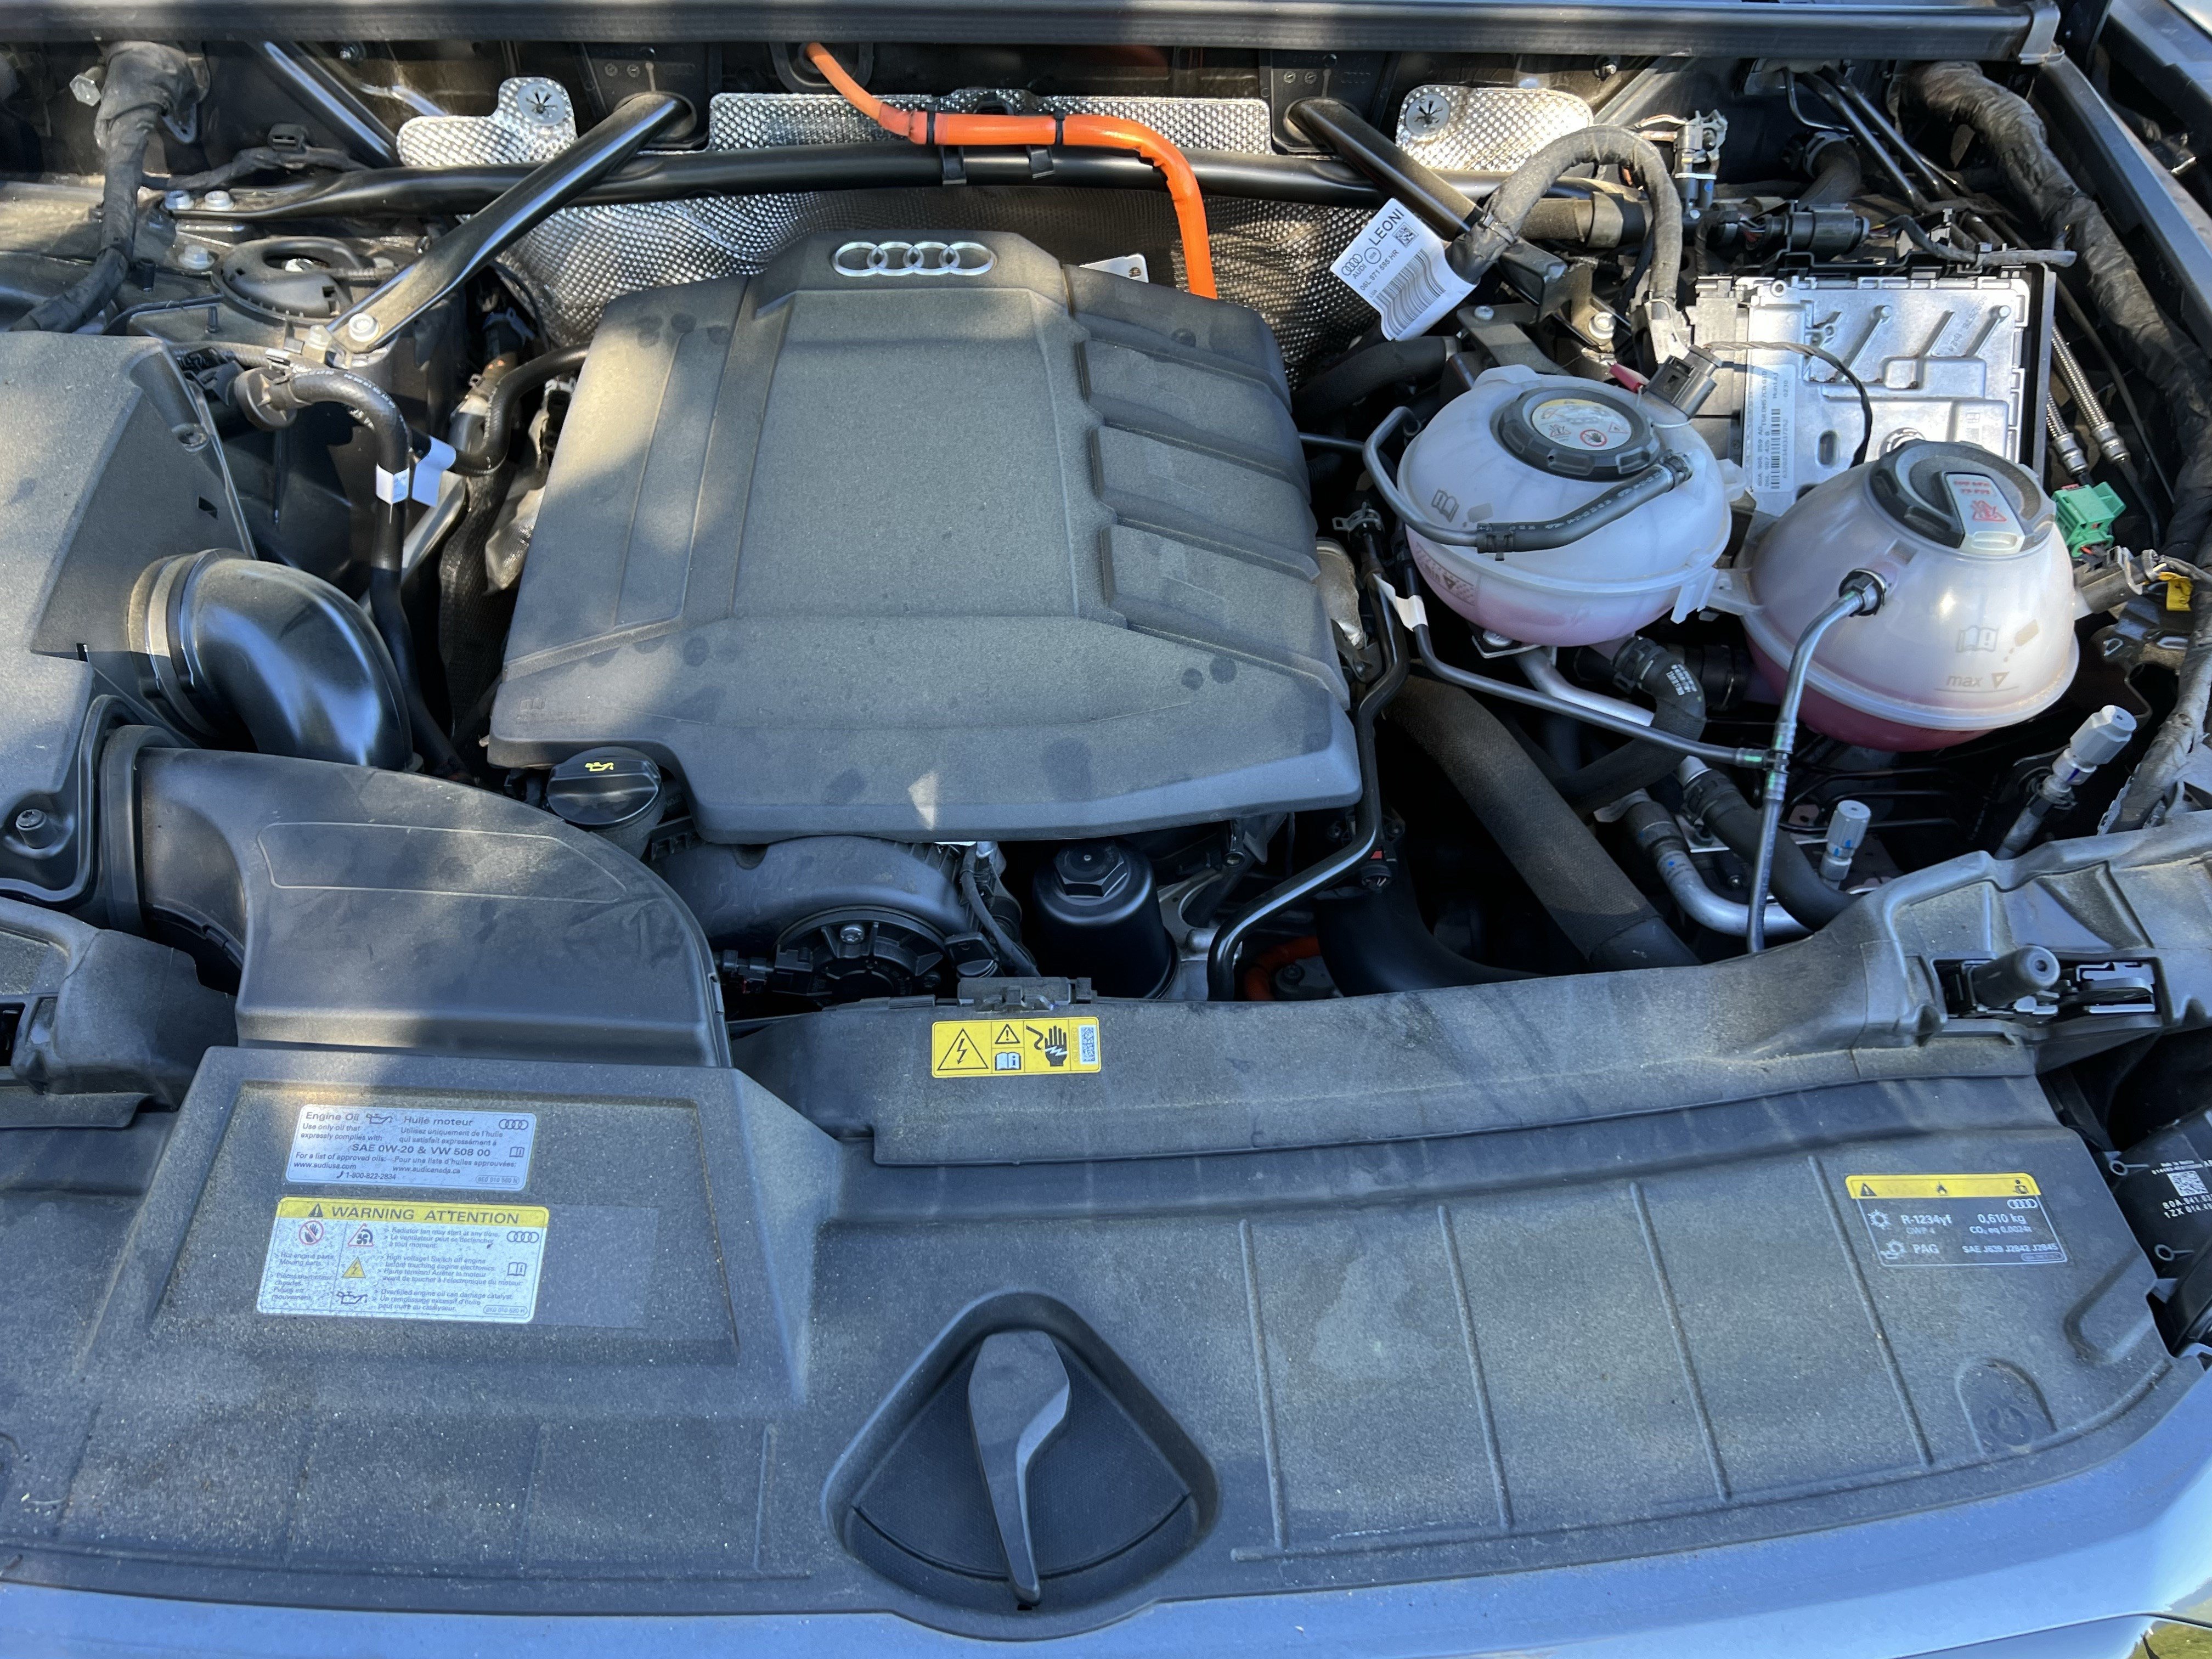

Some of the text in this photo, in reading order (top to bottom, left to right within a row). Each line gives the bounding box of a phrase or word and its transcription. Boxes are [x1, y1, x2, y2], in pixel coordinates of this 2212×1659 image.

[1368, 208, 1404, 246] LEONI
[1369, 269, 1381, 280] 971
[1379, 260, 1391, 271] 595
[1389, 250, 1399, 262] HR
[1352, 264, 1366, 279] AUDI
[1946, 675, 1983, 687] max
[306, 1112, 359, 1121] Engine Oil
[404, 1116, 430, 1125] Huile
[301, 1133, 334, 1141] expressly
[335, 1133, 366, 1142] complies
[401, 1127, 426, 1136] Utilisez
[428, 1129, 470, 1138] uniquement
[399, 1136, 410, 1144] qui
[411, 1137, 439, 1145] satisfait
[441, 1138, 491, 1147] expressément
[378, 1144, 415, 1154] 0W-20
[418, 1146, 429, 1154] &
[431, 1147, 452, 1155] VW
[454, 1147, 473, 1156] 508
[336, 1154, 370, 1163] approved
[371, 1154, 387, 1163] oils:
[444, 1158, 472, 1166] d'huiles
[294, 1161, 357, 1171] www.audiusa.com
[392, 1166, 460, 1174] www.audicanada.ca
[345, 1172, 397, 1180] 1-800-822-2834
[331, 1206, 519, 1224] WARNING ATTENTION
[1900, 1214, 1953, 1227] R-1234yf
[2010, 1213, 2027, 1224] kg
[1913, 1244, 1940, 1255] PAG
